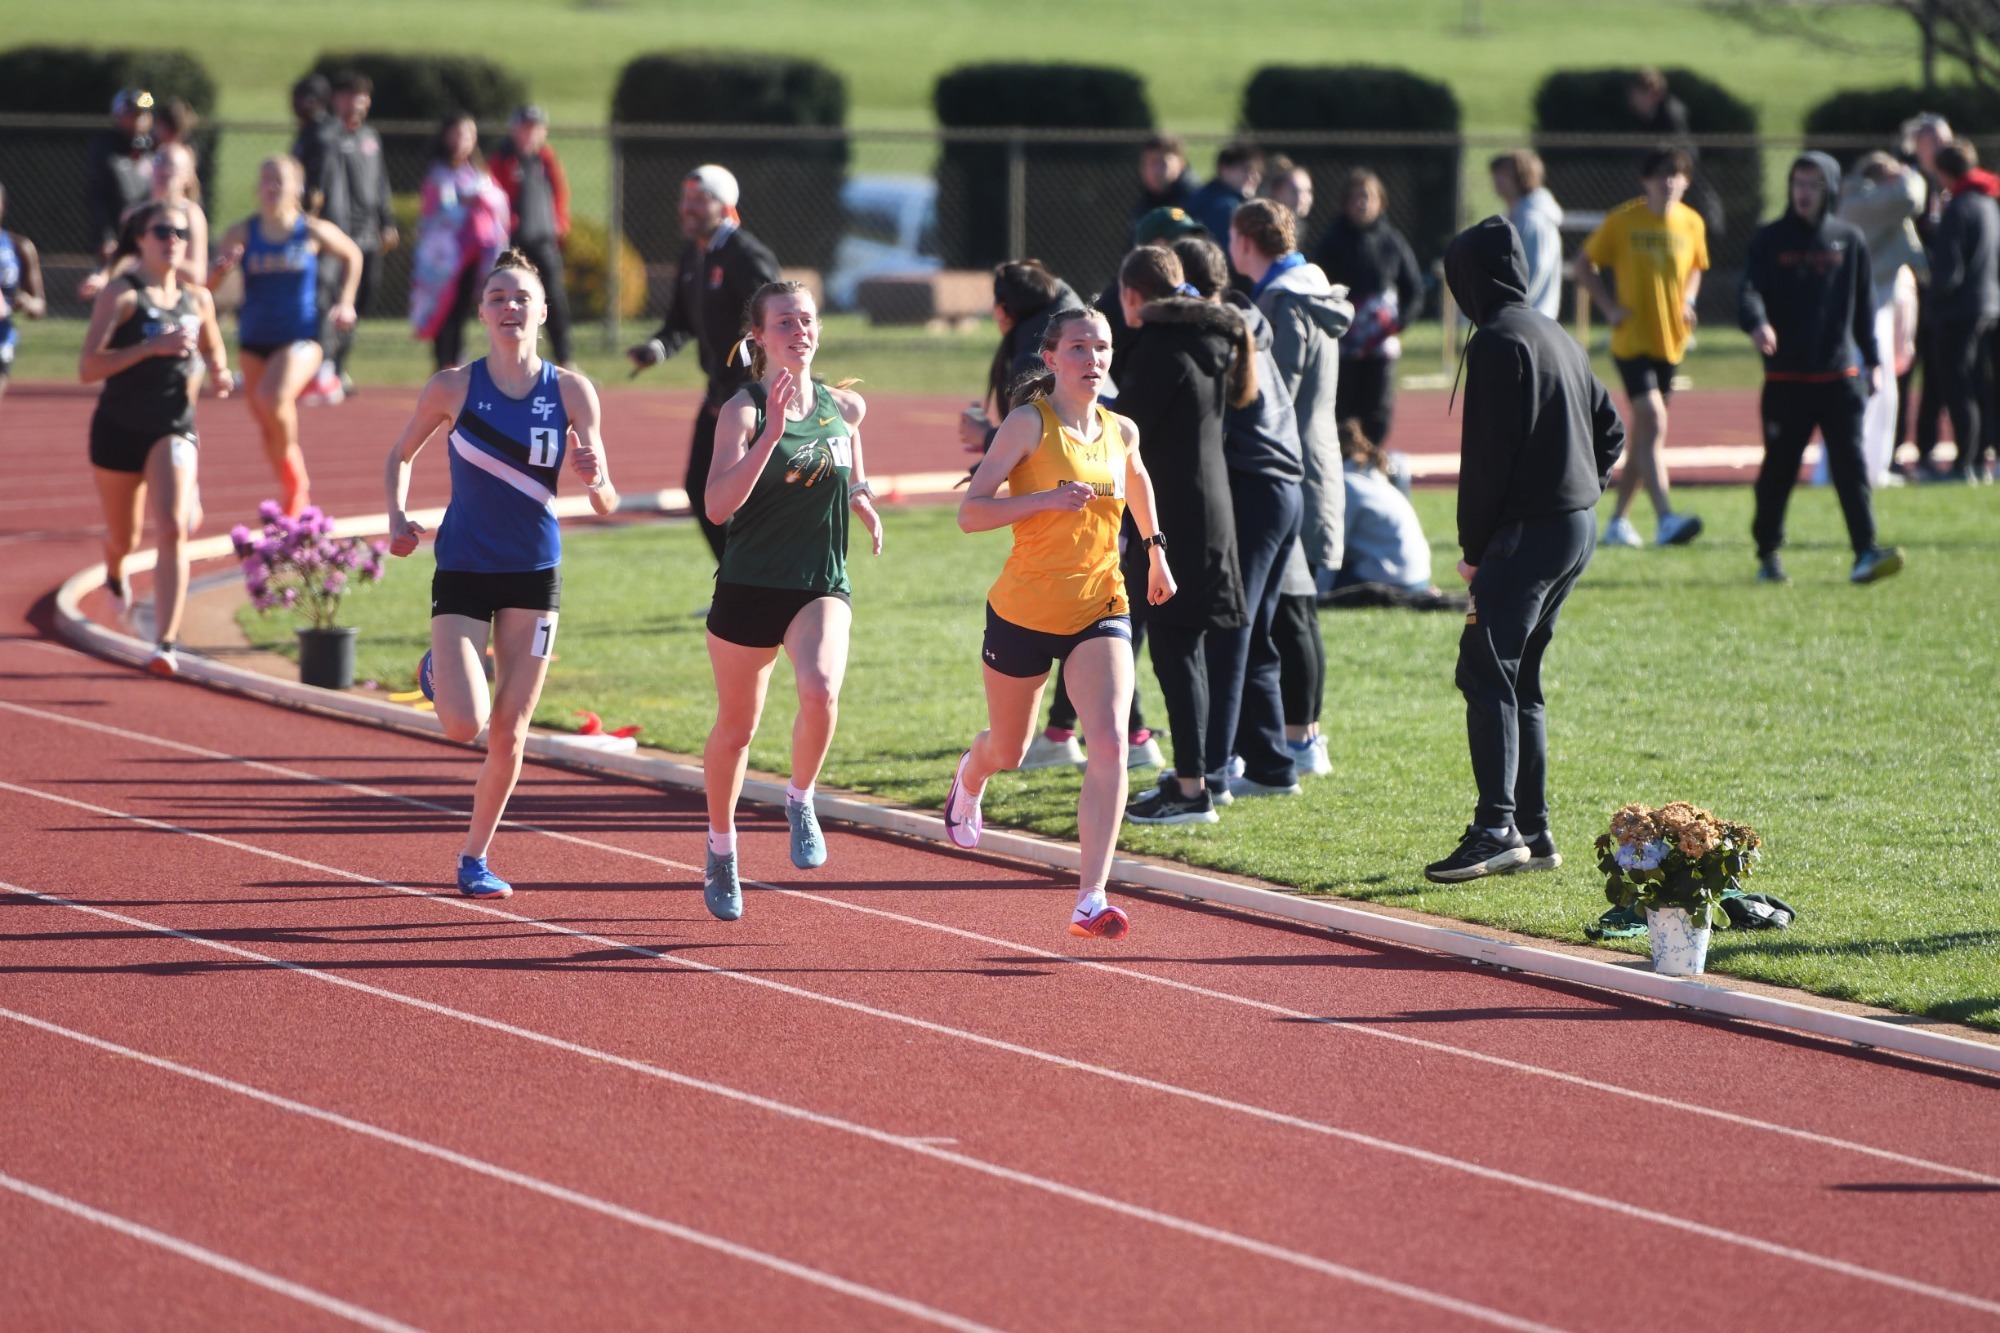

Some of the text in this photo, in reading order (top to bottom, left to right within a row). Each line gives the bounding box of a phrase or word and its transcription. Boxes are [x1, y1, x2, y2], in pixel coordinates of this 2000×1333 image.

[531, 396, 557, 421] SF
[535, 430, 549, 465] 1
[540, 623, 552, 656] 1
